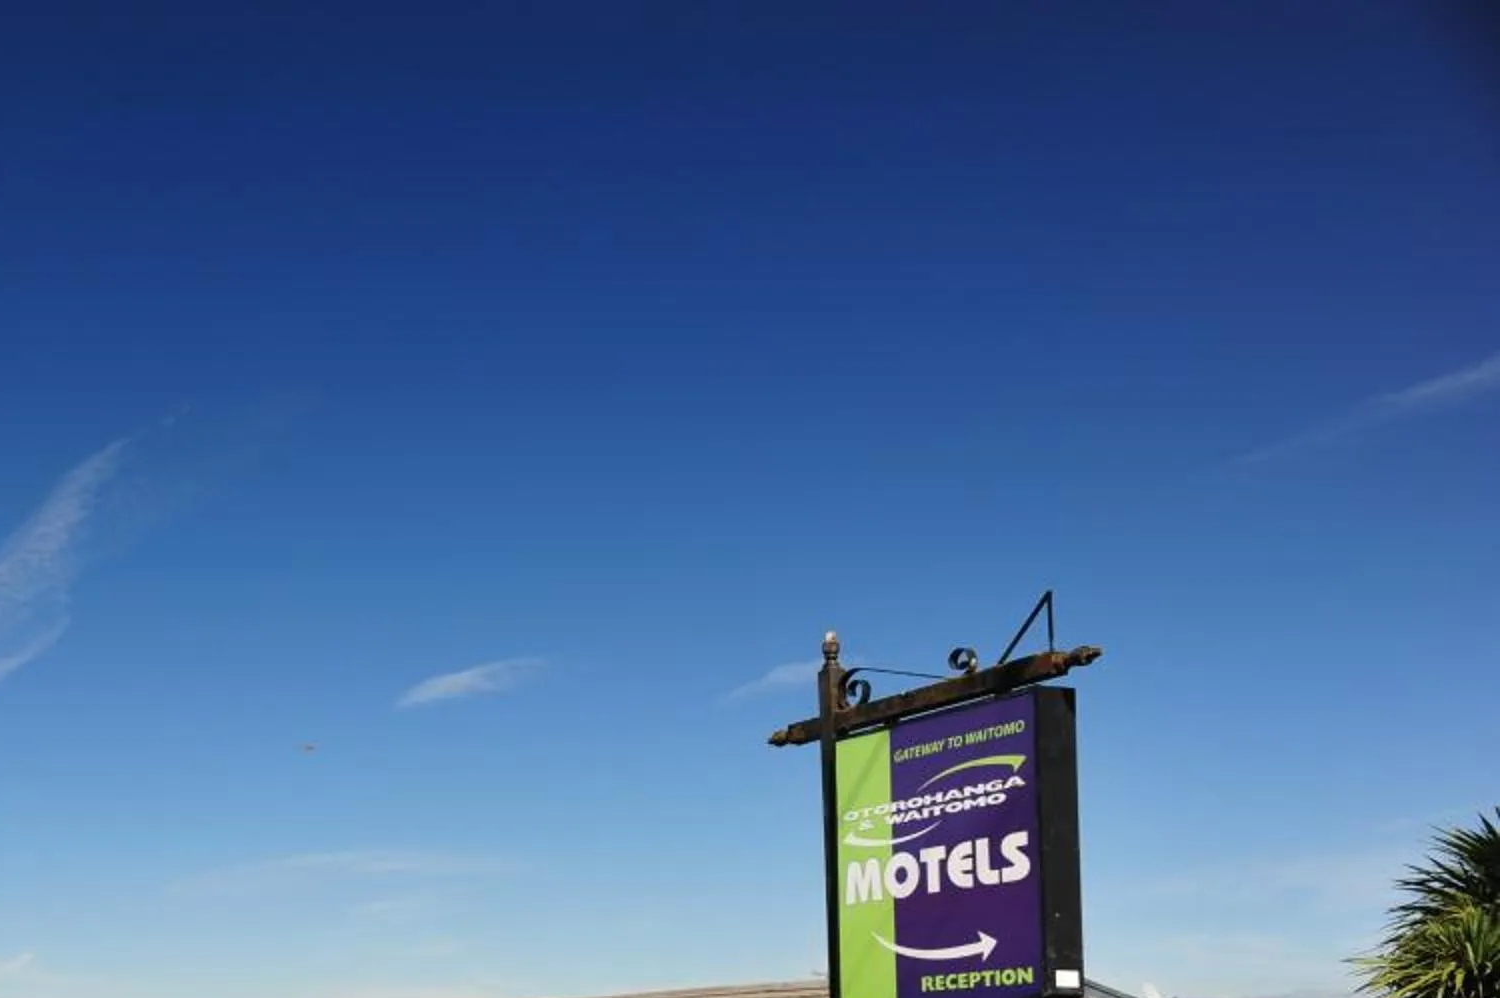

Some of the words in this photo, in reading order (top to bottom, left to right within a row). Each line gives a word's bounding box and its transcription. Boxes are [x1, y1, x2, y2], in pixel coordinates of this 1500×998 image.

[893, 740, 946, 763] GATEWAY
[947, 735, 963, 750] TO
[965, 719, 1026, 745] WAITOMO
[844, 776, 1025, 821] OTOROHANGA
[885, 793, 1006, 826] WAITOMO
[846, 831, 1030, 905] MOTELS
[920, 966, 1034, 993] RECEPTION
